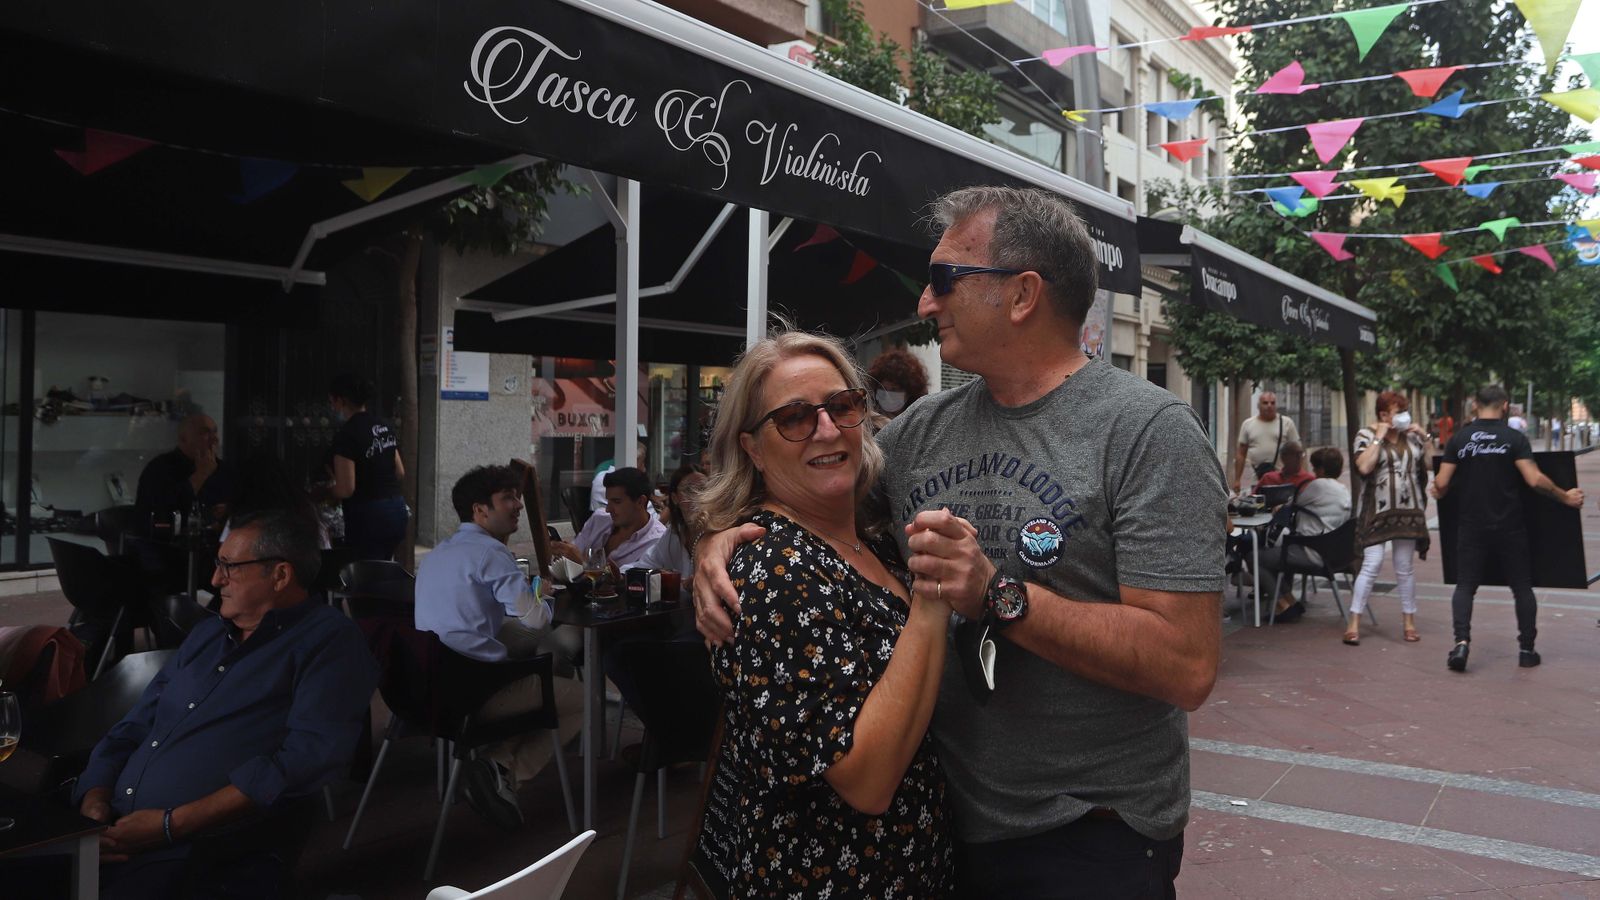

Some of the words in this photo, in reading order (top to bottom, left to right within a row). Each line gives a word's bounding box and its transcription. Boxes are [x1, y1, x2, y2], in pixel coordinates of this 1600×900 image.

[463, 26, 638, 127] Tasca
[654, 79, 752, 191] El
[744, 119, 882, 198] Violinista
[902, 452, 1021, 521] GROVELAND
[1018, 463, 1089, 539] LODGE
[975, 502, 1026, 522] GREAT
